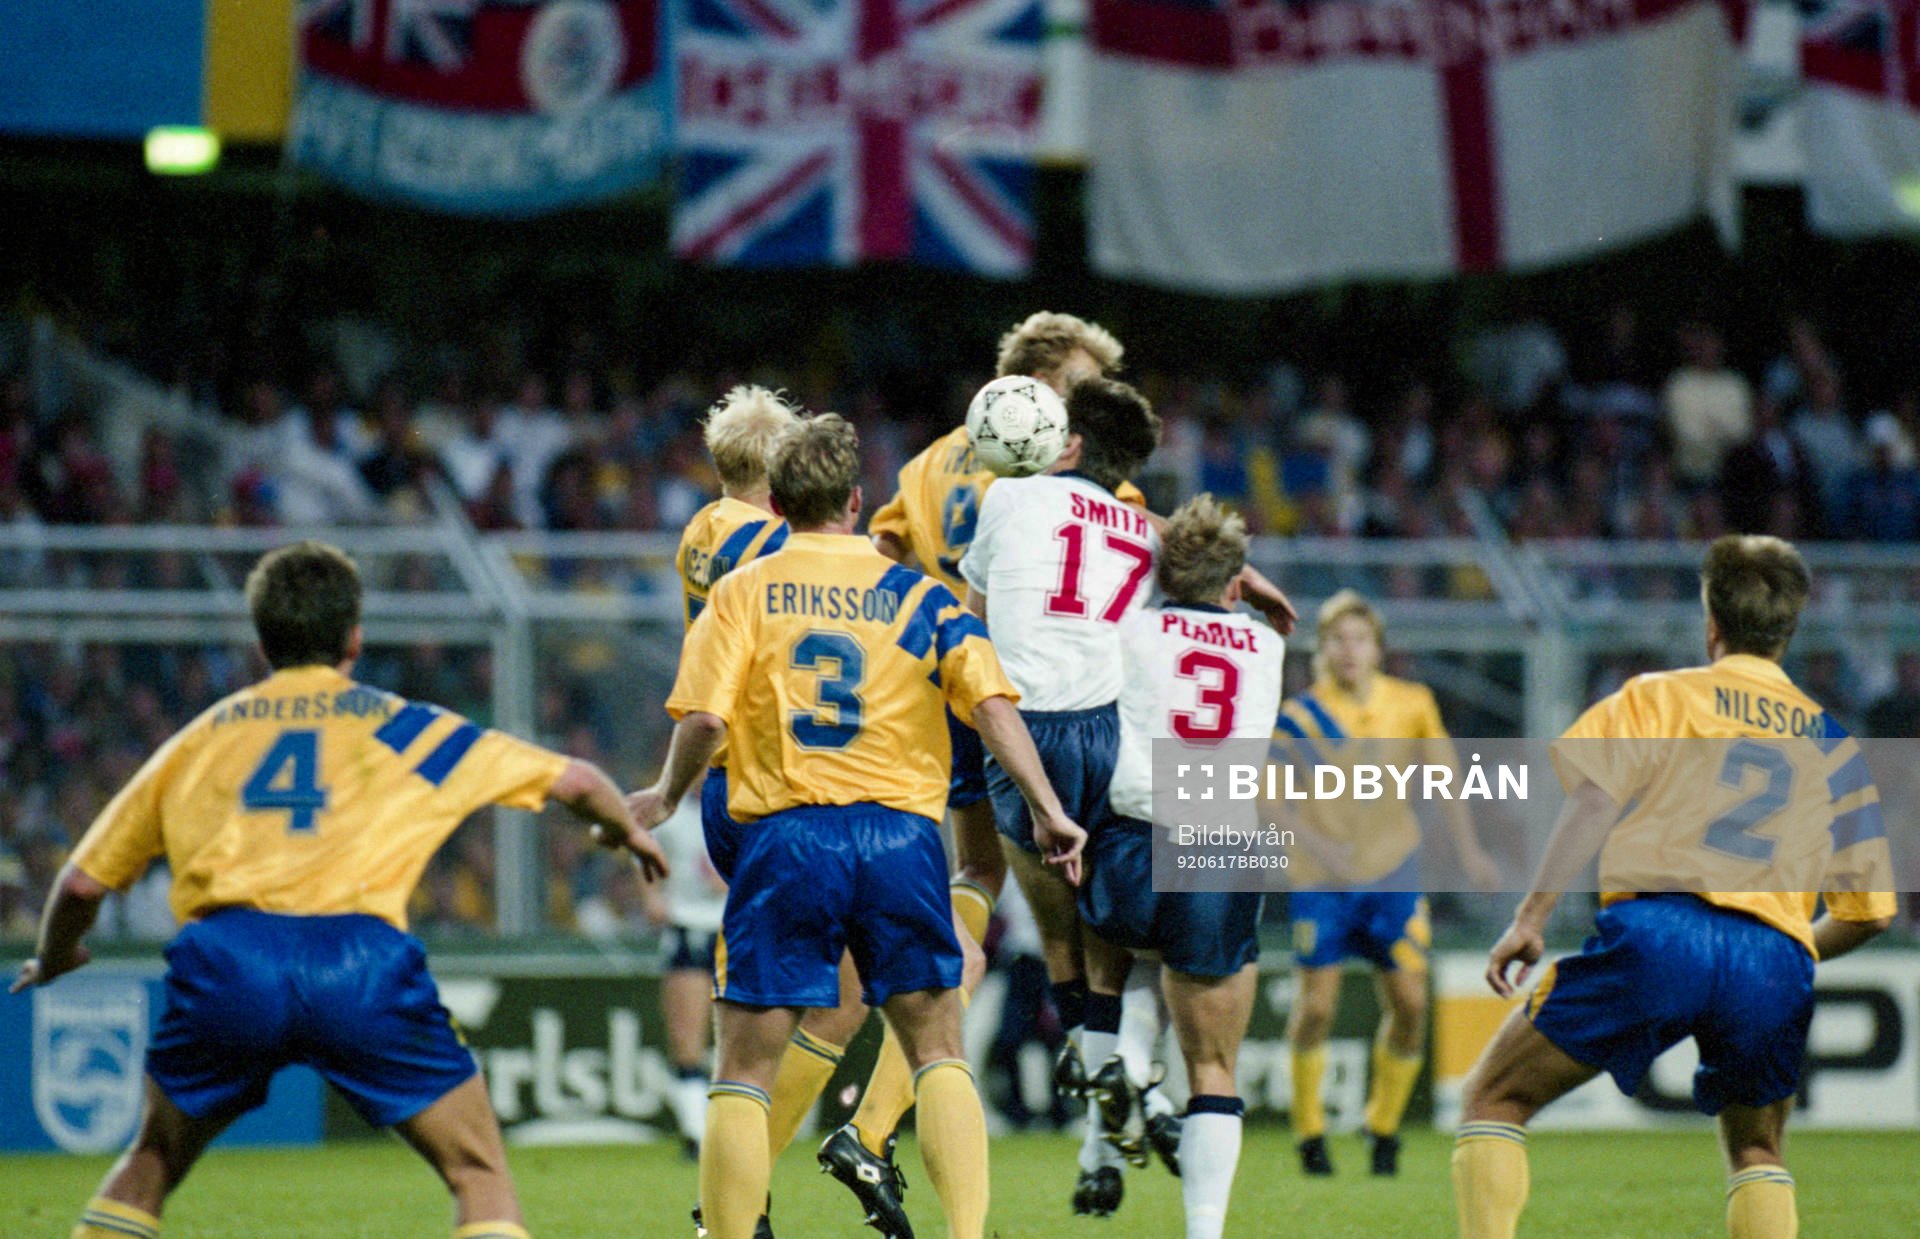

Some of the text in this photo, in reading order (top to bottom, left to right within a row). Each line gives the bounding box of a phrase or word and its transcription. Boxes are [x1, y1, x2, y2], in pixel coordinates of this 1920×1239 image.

[1071, 492, 1147, 538] SMITH
[766, 583, 899, 625] ERIKSSON
[1044, 520, 1153, 624] 17
[787, 628, 868, 752] 3
[1168, 647, 1243, 750] 3
[1714, 686, 1827, 742] NILSSON
[240, 728, 332, 833] 4
[1698, 736, 1796, 866] 2
